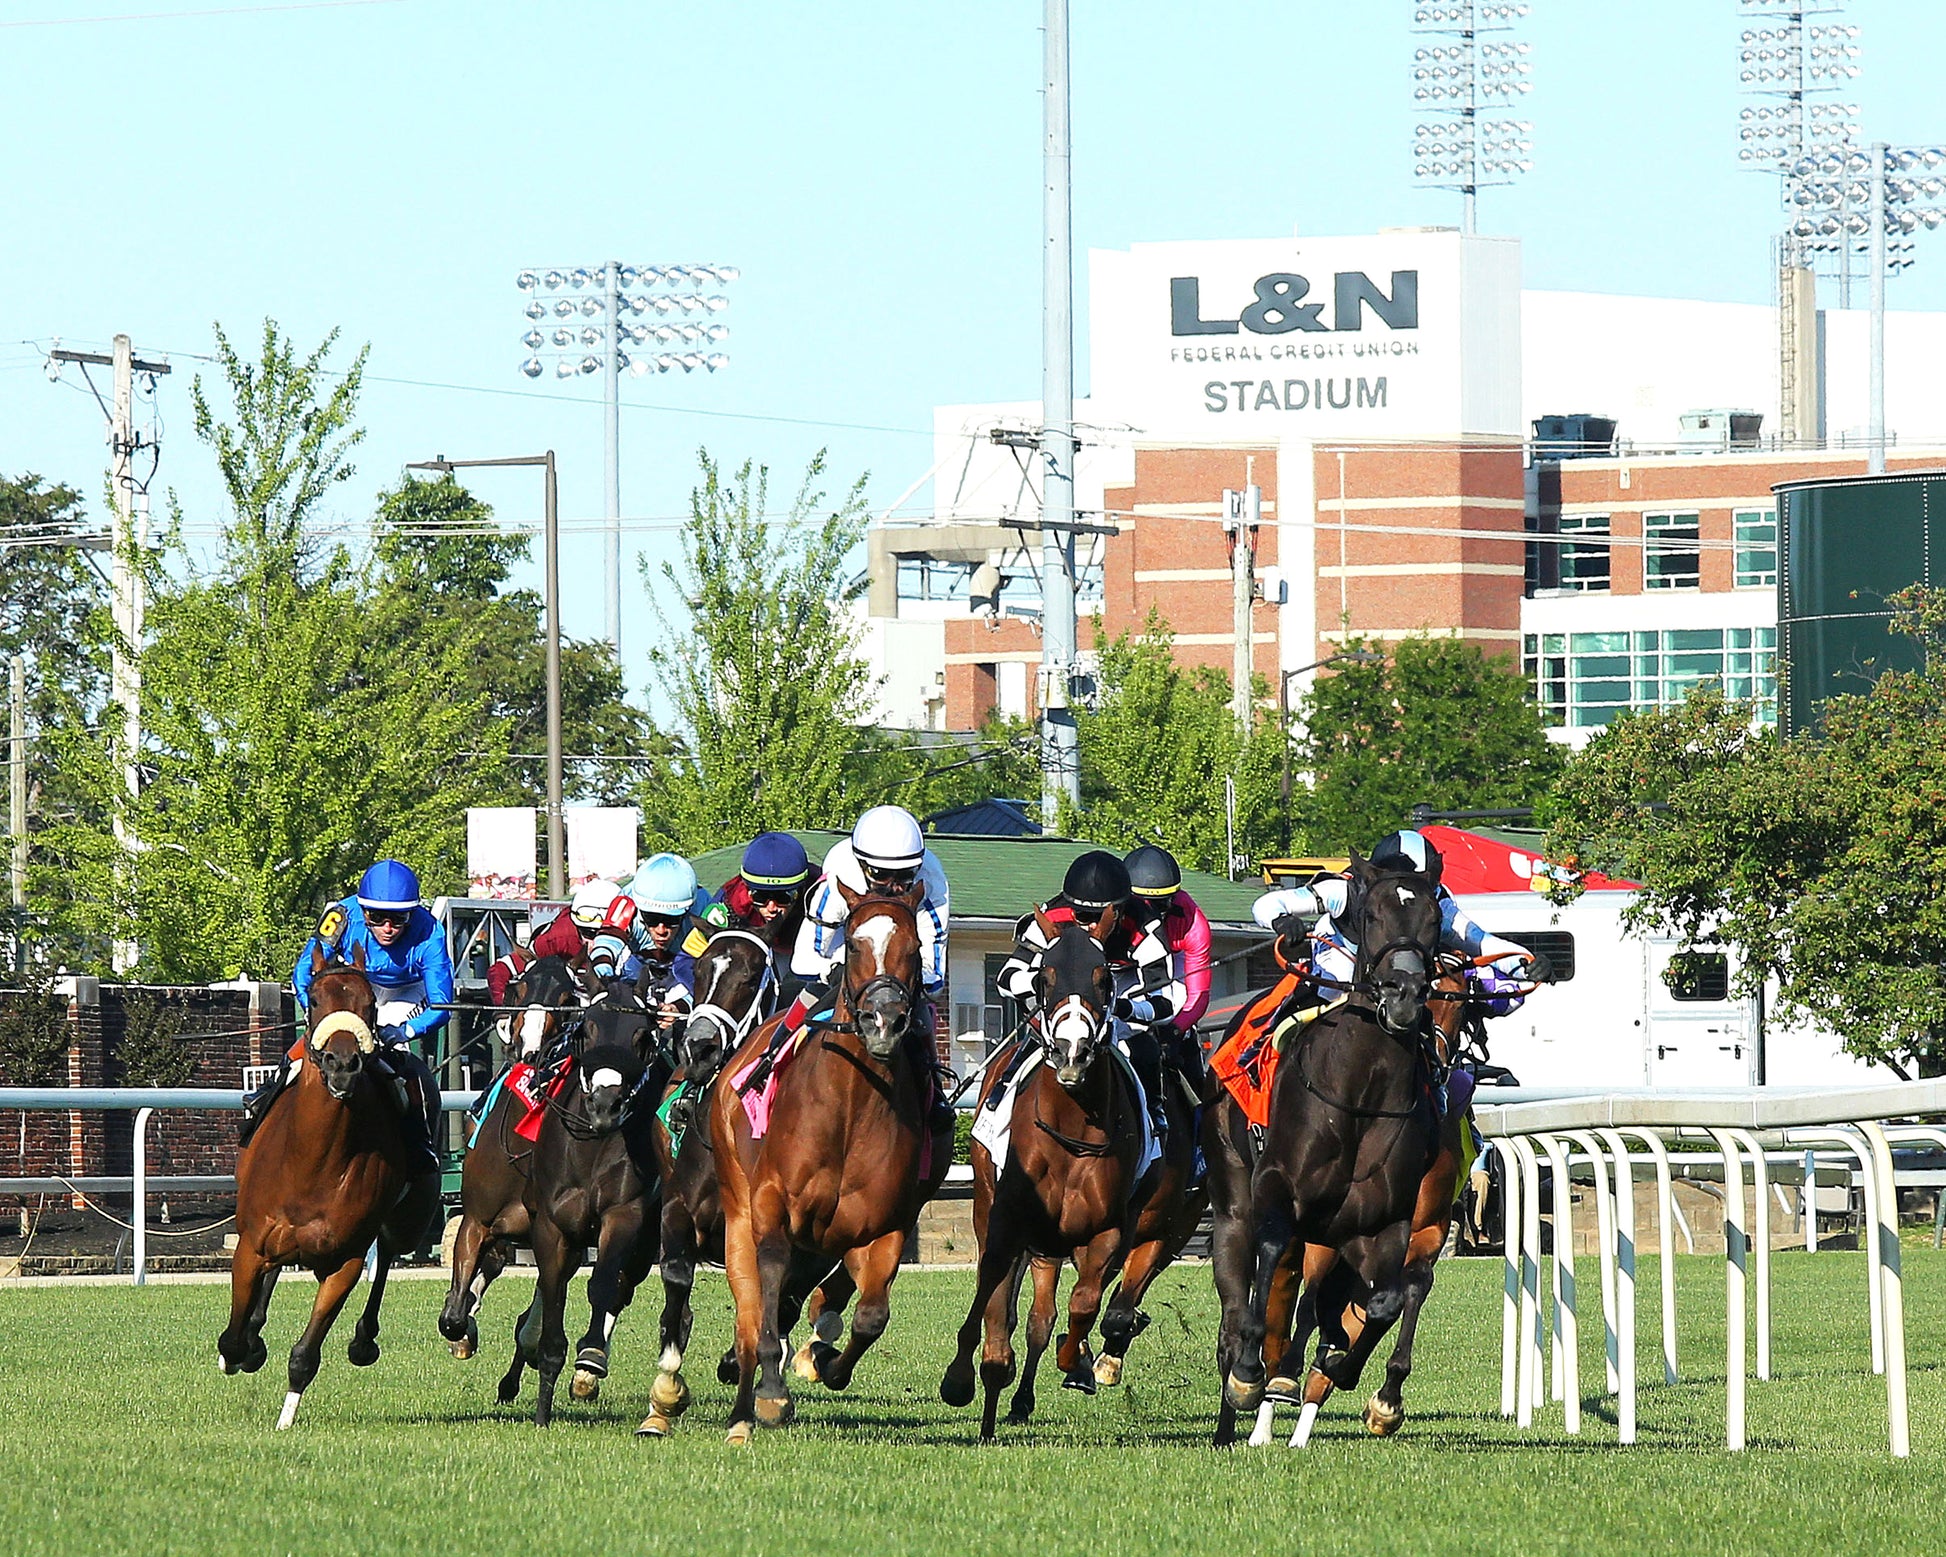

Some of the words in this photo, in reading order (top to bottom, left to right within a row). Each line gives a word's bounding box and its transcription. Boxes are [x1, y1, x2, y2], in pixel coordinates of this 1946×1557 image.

[1170, 270, 1418, 336] L&N
[1171, 346, 1262, 362] FEDERAL
[1270, 343, 1345, 360] CREDIT
[1353, 341, 1419, 357] UNION
[1204, 376, 1388, 413] STADIUM
[319, 911, 342, 937] 6
